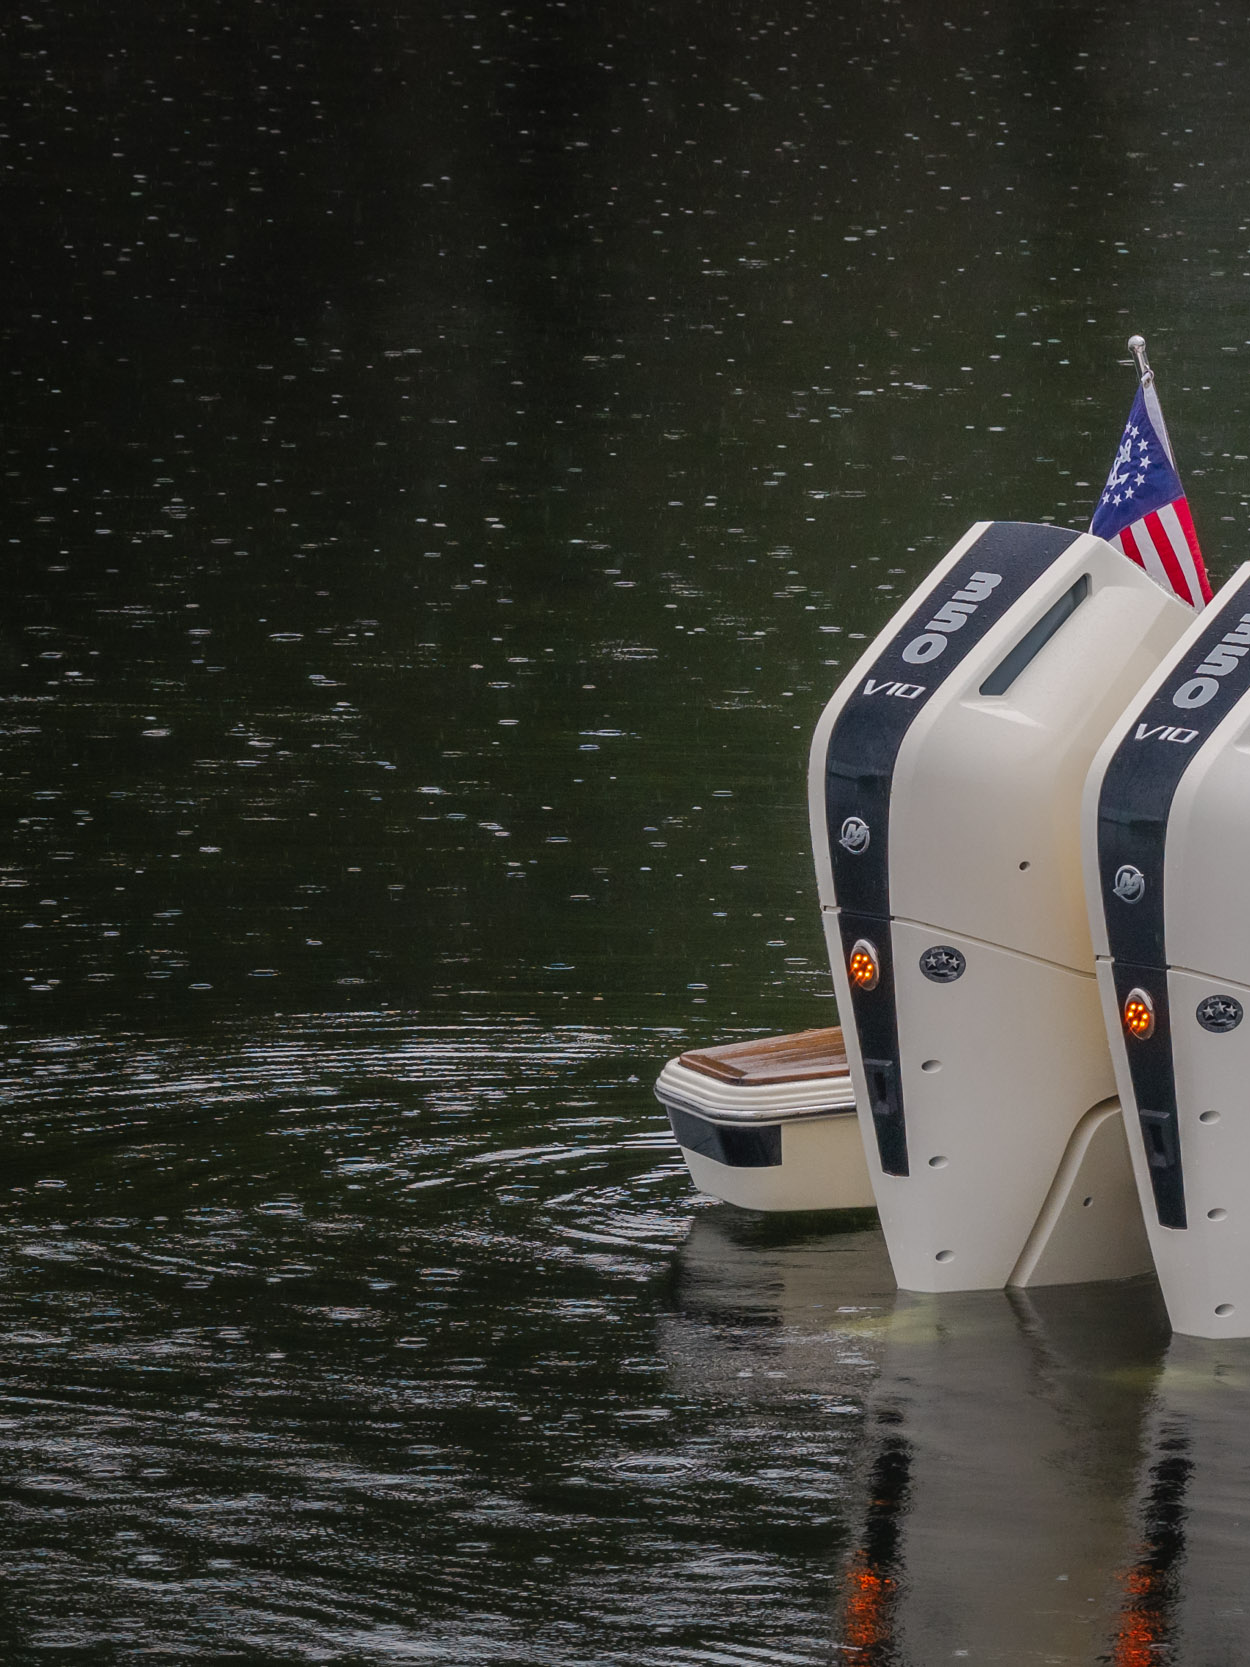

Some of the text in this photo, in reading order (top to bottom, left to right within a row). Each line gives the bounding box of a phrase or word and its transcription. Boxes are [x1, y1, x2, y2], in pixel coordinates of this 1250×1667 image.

[902, 571, 1003, 664] 350
[863, 679, 926, 699] V10
[1135, 723, 1199, 743] V10
